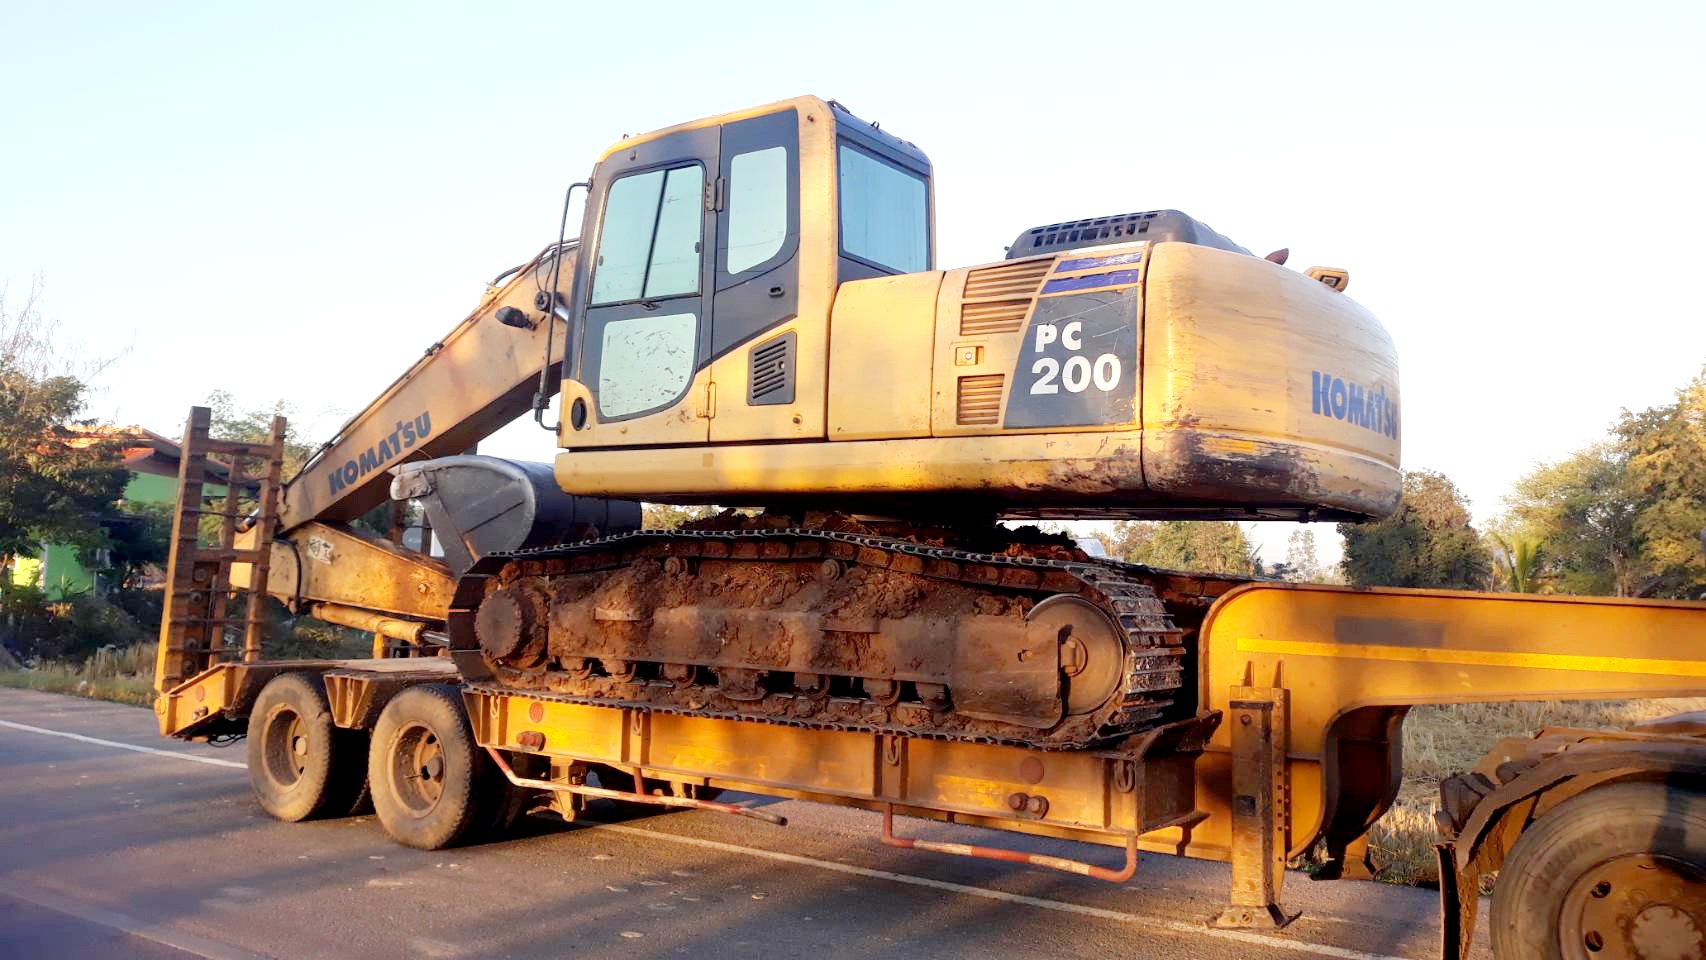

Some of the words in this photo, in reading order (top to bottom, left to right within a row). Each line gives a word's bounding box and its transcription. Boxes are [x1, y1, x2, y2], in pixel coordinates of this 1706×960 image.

[1035, 322, 1082, 353] PC
[1030, 353, 1122, 395] 200
[1311, 367, 1398, 440] KOMATSU
[328, 410, 431, 497] KOMATSU
